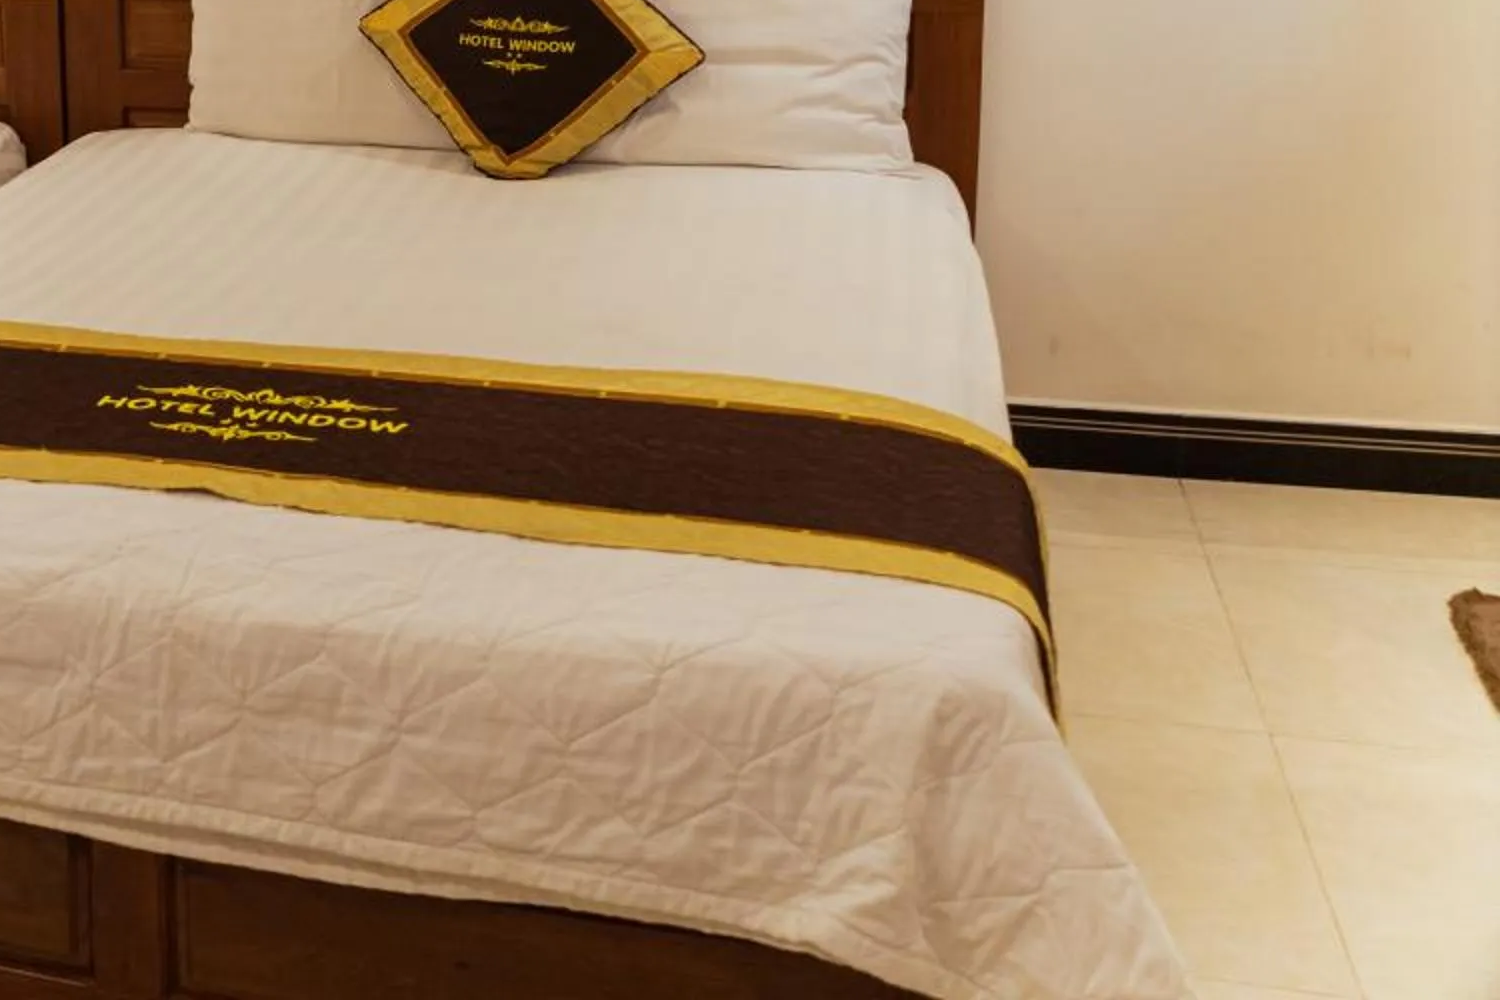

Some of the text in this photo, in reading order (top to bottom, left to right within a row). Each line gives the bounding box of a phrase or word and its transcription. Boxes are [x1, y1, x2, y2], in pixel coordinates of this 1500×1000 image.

[459, 33, 576, 53] HOTEL WINDOW
[97, 395, 409, 433] HOTEL WINDOW
